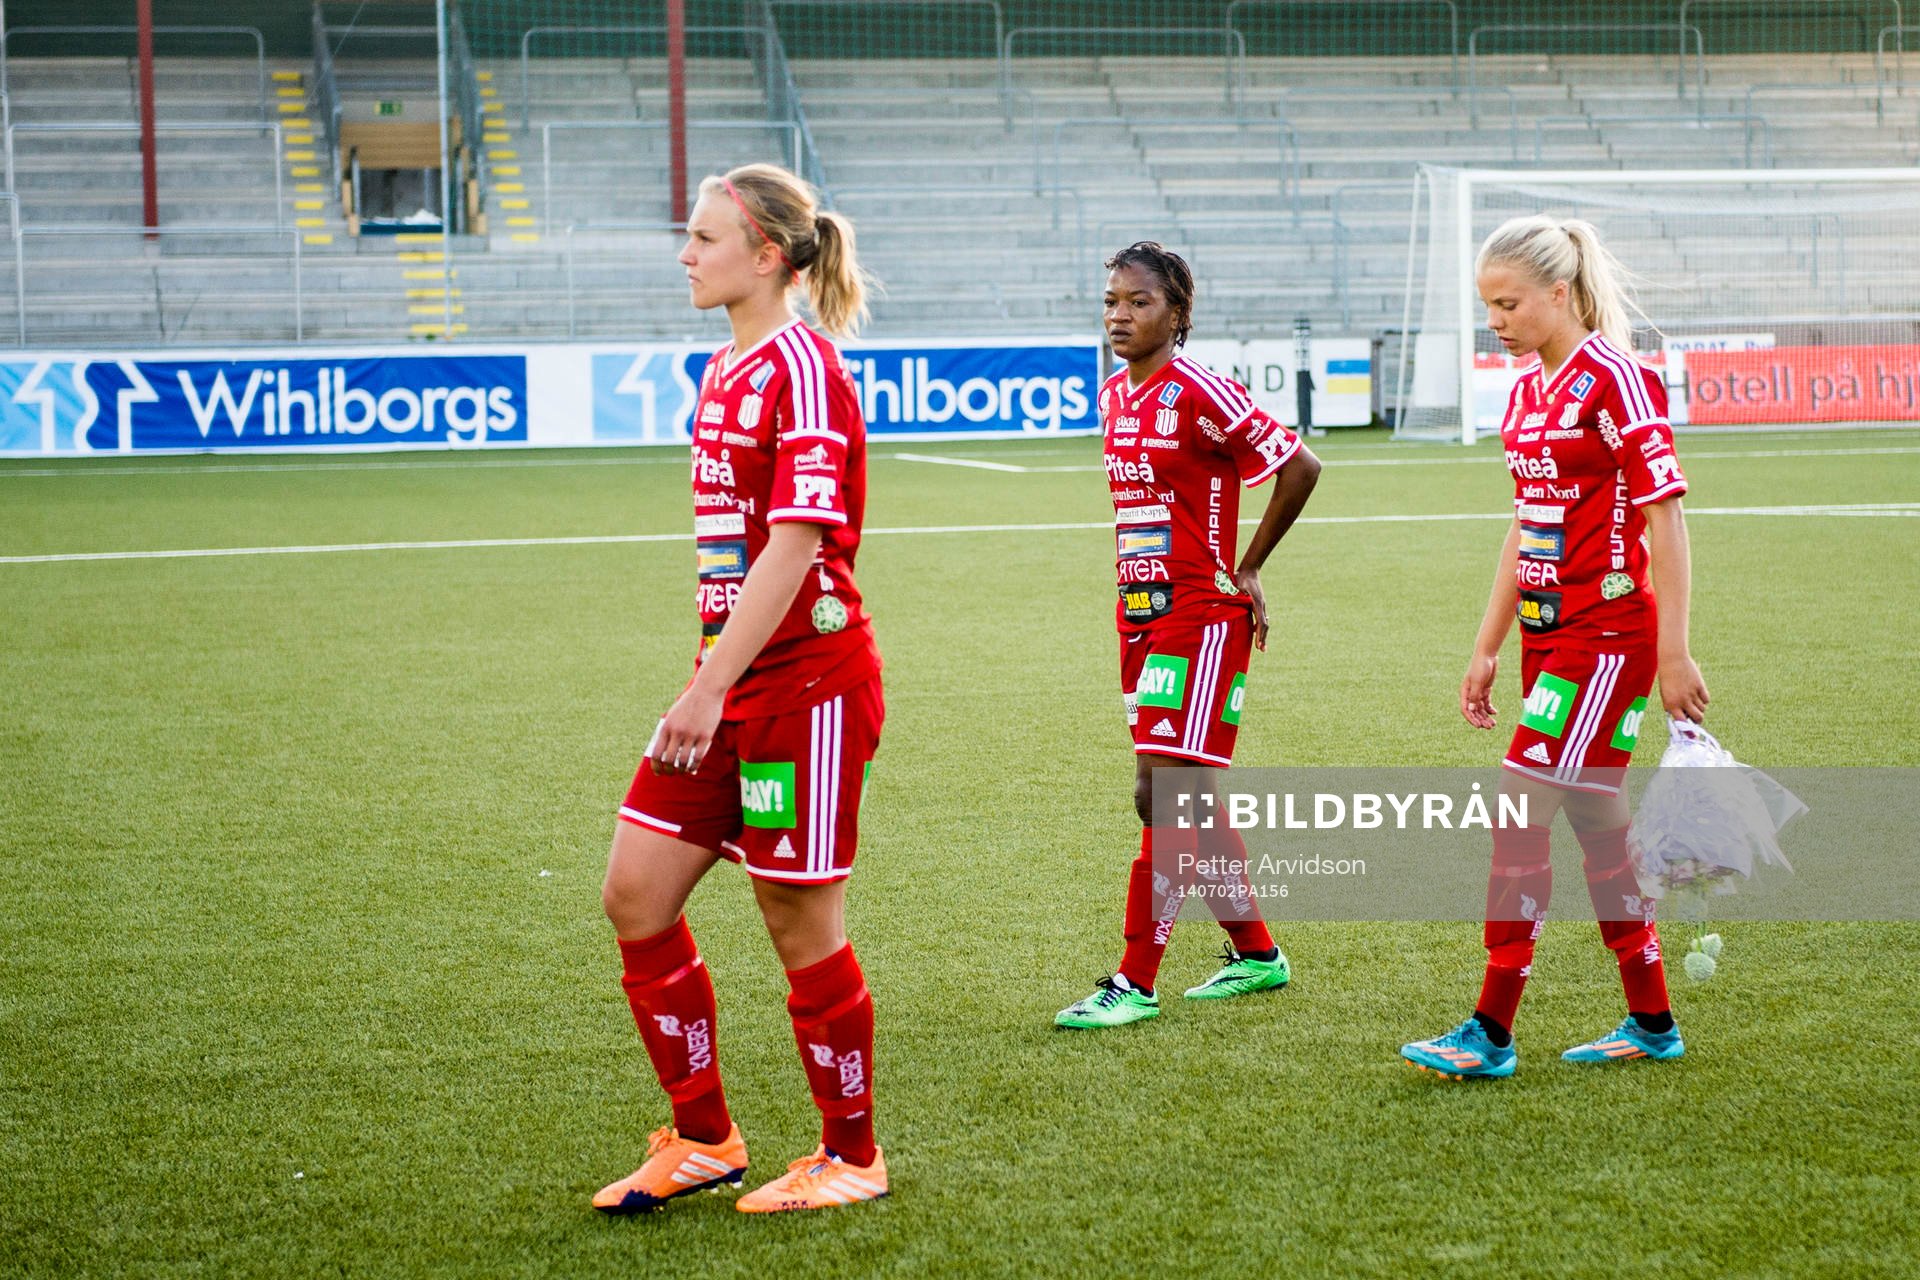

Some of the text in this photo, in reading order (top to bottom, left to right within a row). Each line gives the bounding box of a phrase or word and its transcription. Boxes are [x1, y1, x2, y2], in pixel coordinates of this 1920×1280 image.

[177, 367, 518, 443] Wihlborgs
[844, 357, 1089, 433] ihlborgs
[1662, 362, 1920, 411] Hotell på hj
[1255, 426, 1293, 466] PT
[1504, 446, 1559, 480] Piteå
[1103, 452, 1155, 484] Piteå
[793, 475, 837, 509] PT
[1117, 559, 1170, 582] ATEA
